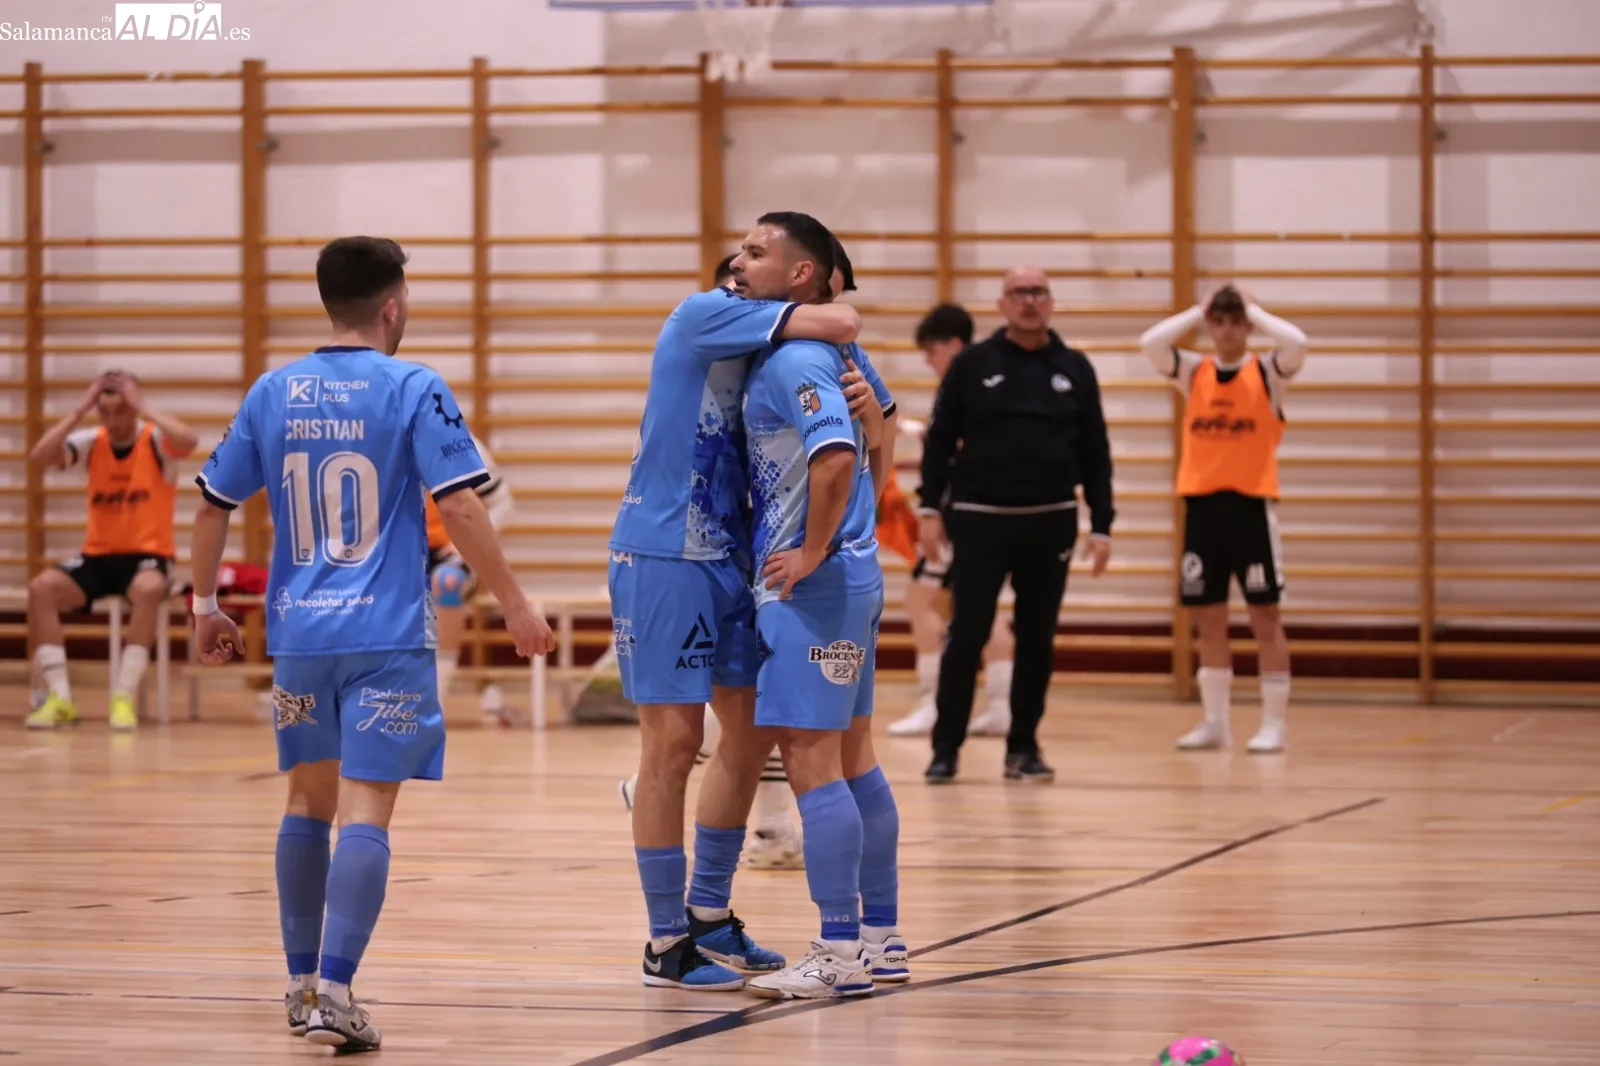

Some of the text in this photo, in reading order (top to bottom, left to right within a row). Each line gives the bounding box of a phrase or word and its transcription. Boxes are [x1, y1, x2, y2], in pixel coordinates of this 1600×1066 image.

[324, 381, 369, 390] KITCHEN
[323, 393, 350, 403] PLUS
[282, 451, 380, 567] 10
[810, 648, 865, 662] BROCENSE
